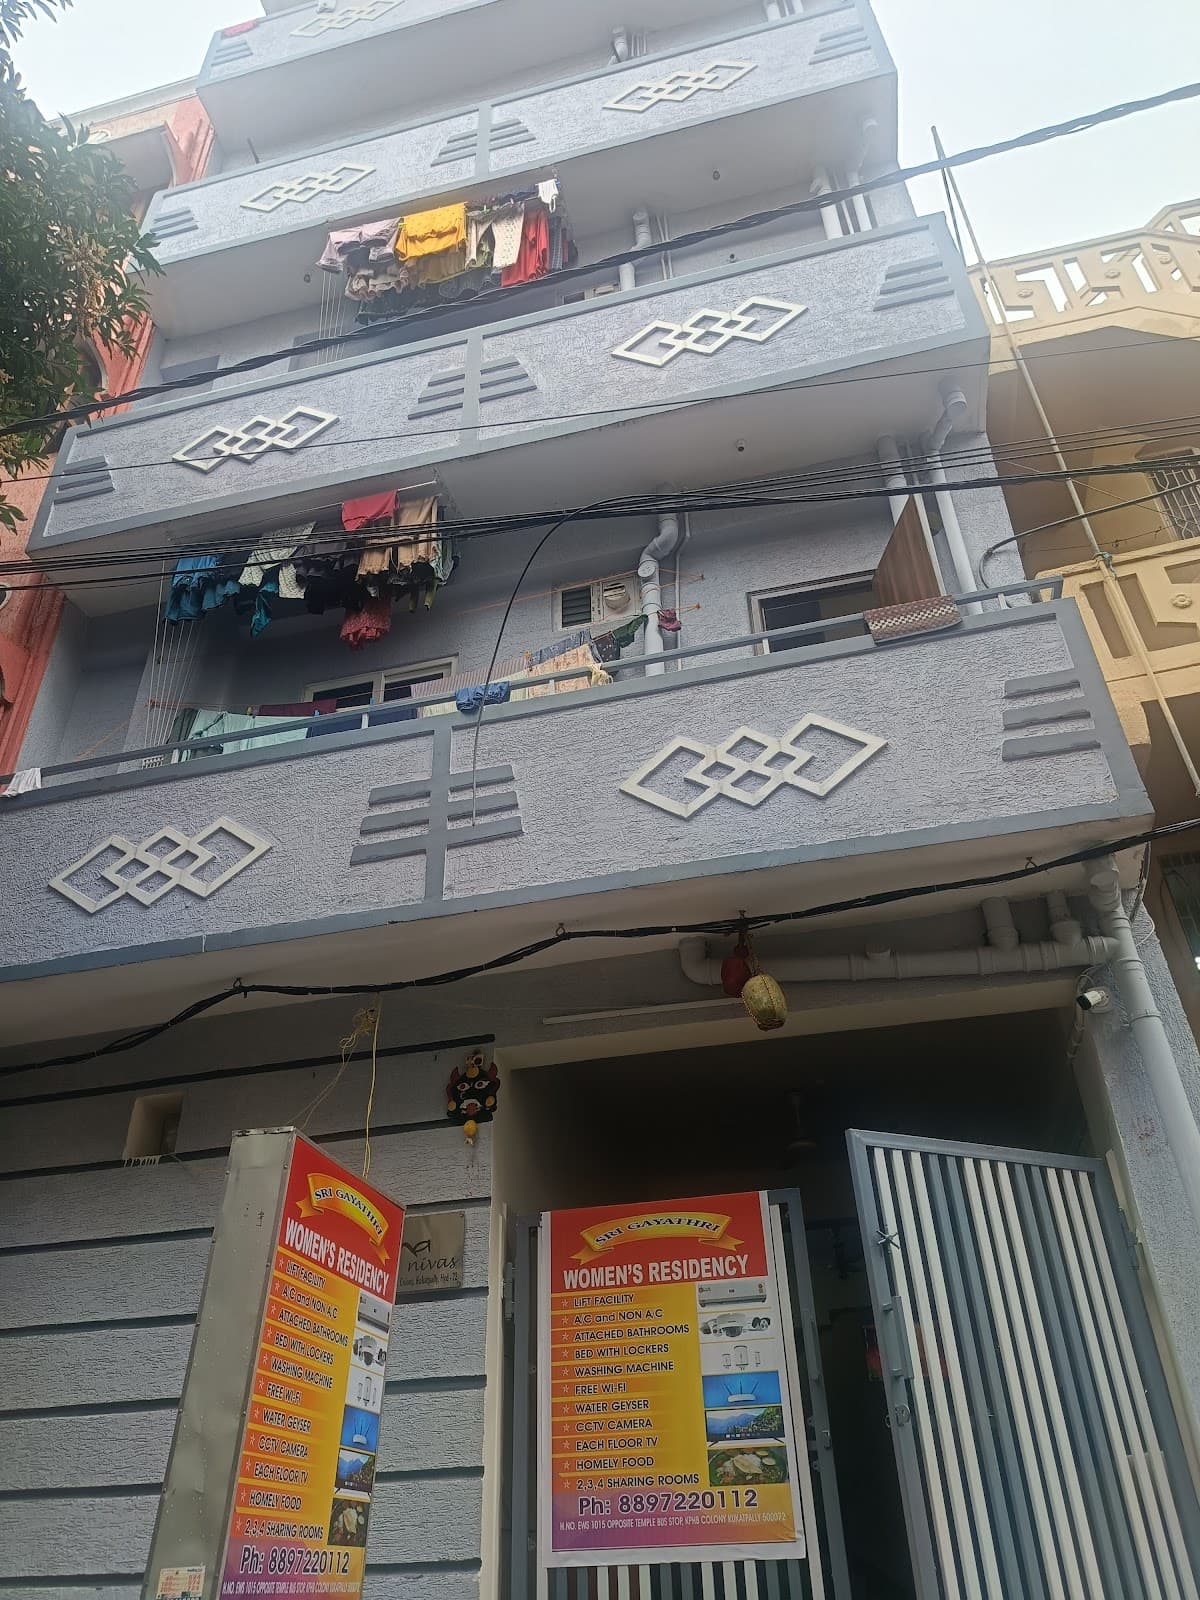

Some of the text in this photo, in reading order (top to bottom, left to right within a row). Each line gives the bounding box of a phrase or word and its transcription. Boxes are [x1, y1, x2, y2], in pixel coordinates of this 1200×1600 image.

[314, 1187, 383, 1238] SRI GAYATHRI
[595, 1215, 721, 1246] SRI GAYATHRI
[284, 1217, 390, 1297] WOMEN'S RESIDENCY
[299, 1266, 326, 1289] FACILITY
[563, 1254, 749, 1290] WOMEN'S RESIDENCY
[297, 1293, 310, 1307] and
[311, 1296, 326, 1313] NON
[573, 1293, 635, 1308] LIFT FACILITY
[595, 1313, 616, 1323] and
[618, 1310, 642, 1320] NON
[278, 1308, 349, 1347] ATTACHED BATHROOMS
[574, 1324, 690, 1342] ATTACHED BATHROOMS
[275, 1333, 334, 1366] BED WITH LOCKERS
[574, 1343, 670, 1360] BED WITH LOCKERS
[270, 1355, 334, 1389] WASHING MACHINE
[574, 1361, 674, 1378] WASHING MACHINE
[266, 1382, 284, 1400] FREE
[575, 1384, 598, 1395] FREE
[575, 1399, 650, 1414] WATER GEYSER
[262, 1408, 312, 1433] WATER GEYSER
[575, 1417, 653, 1432] CCTV CAMERA
[258, 1436, 309, 1458] CCTV CAMERA
[575, 1436, 658, 1452] EACH FLOOR TV
[254, 1462, 309, 1484] EACH FLOOR TV
[576, 1456, 655, 1470] HOMELY FOOD
[576, 1473, 700, 1491] 2,3,4 SHARING ROOMS
[249, 1490, 302, 1510] HOMELY FOOD
[578, 1488, 759, 1516] Ph: 8897220112
[266, 1521, 297, 1538] SHARING
[298, 1525, 324, 1540] ROOMS
[606, 1518, 635, 1528] OPPOSITE
[635, 1517, 656, 1527] TEMPLE
[700, 1513, 727, 1524] COLONY
[239, 1545, 350, 1575] Ph: 8897220112
